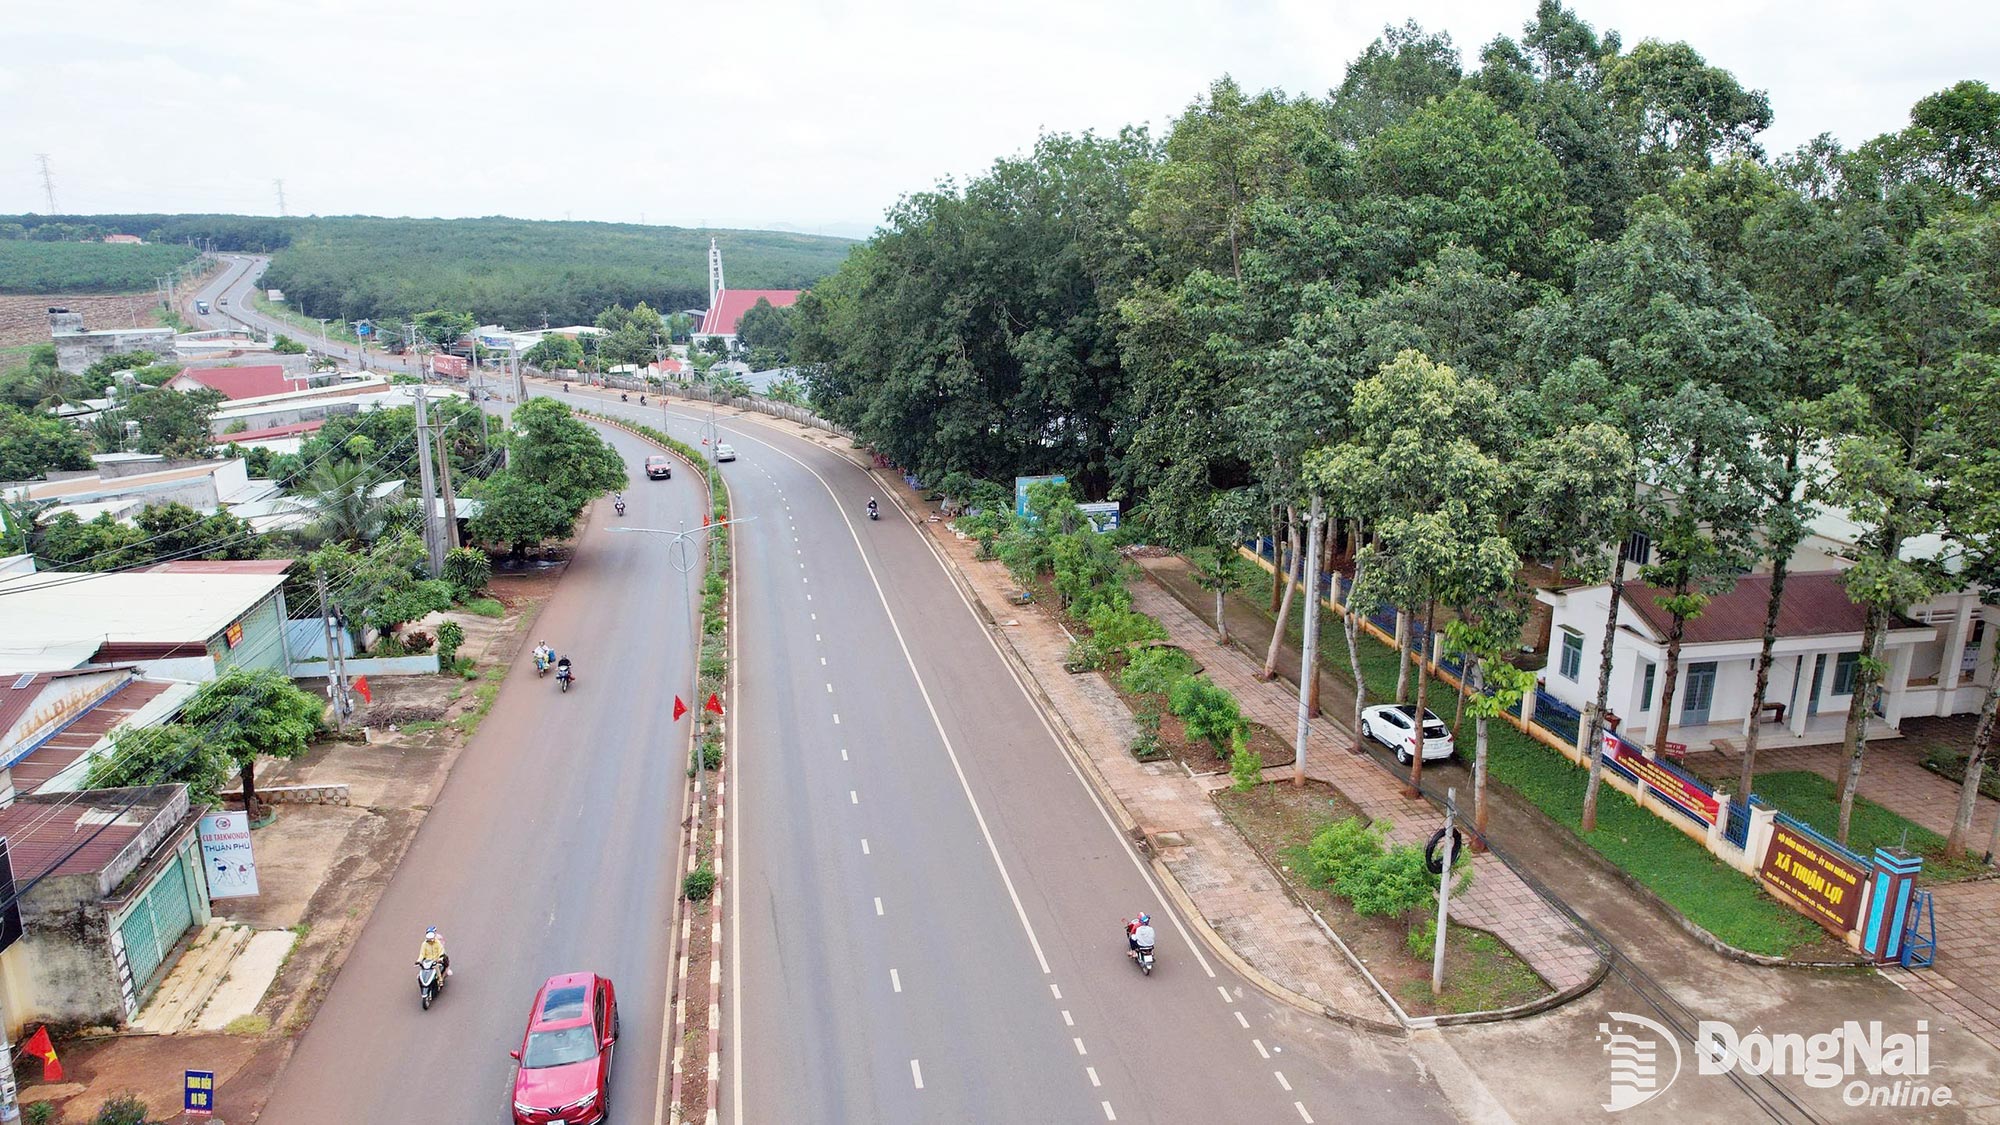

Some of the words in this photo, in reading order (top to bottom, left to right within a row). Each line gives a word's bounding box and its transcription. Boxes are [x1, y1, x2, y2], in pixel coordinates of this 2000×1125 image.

[214, 832, 249, 841] TAEKWONDO
[1775, 852, 1791, 872] XÃ
[1791, 861, 1825, 893] THUẬN
[1824, 882, 1844, 904] LỢI
